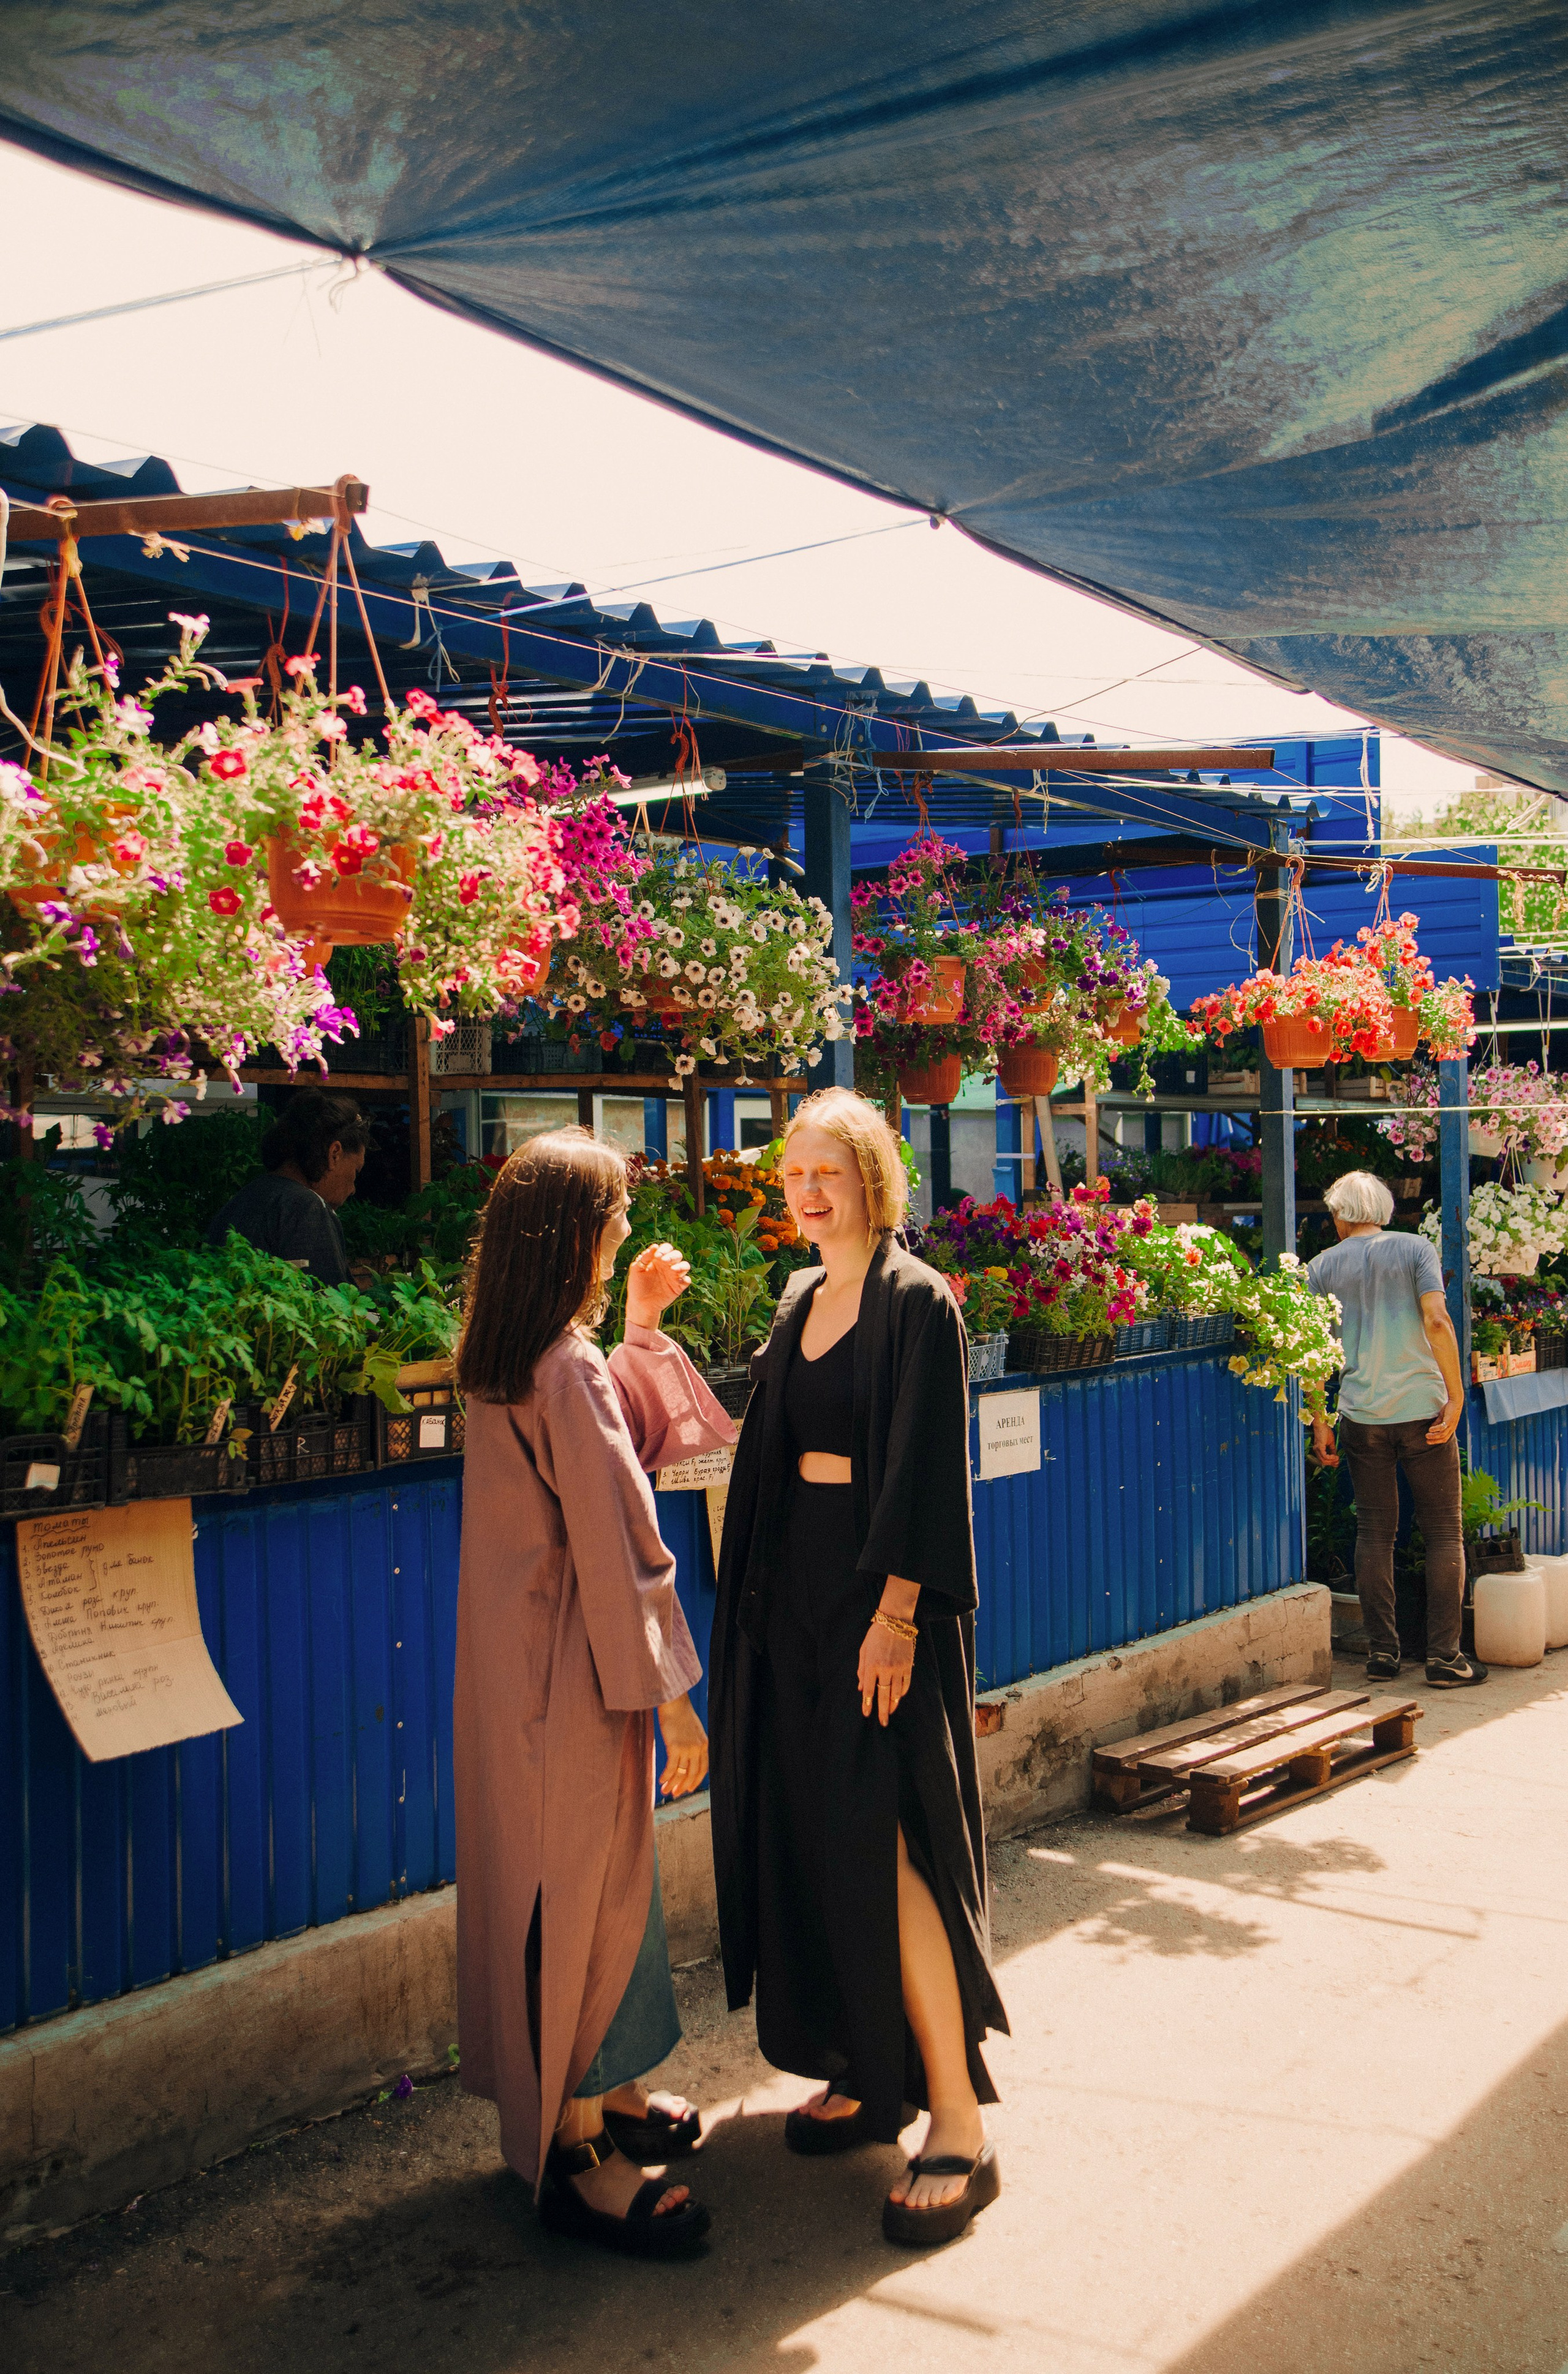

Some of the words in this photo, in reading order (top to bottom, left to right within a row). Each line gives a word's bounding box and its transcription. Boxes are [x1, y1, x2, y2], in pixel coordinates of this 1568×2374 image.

[996, 1416, 1025, 1429] АРЕНДА
[987, 1438, 1018, 1451] торговых
[1019, 1435, 1033, 1445] мест
[34, 1534, 87, 1550] Апельсин
[36, 1548, 77, 1562] Золотое
[81, 1543, 105, 1558] руно
[127, 1553, 154, 1565] банок
[36, 1562, 69, 1578] Звезда
[38, 1573, 83, 1589] Атаман
[40, 1587, 81, 1601] Колобок
[83, 1595, 103, 1610] роза
[86, 1605, 130, 1620] Попович
[47, 1626, 93, 1643] Добрыня
